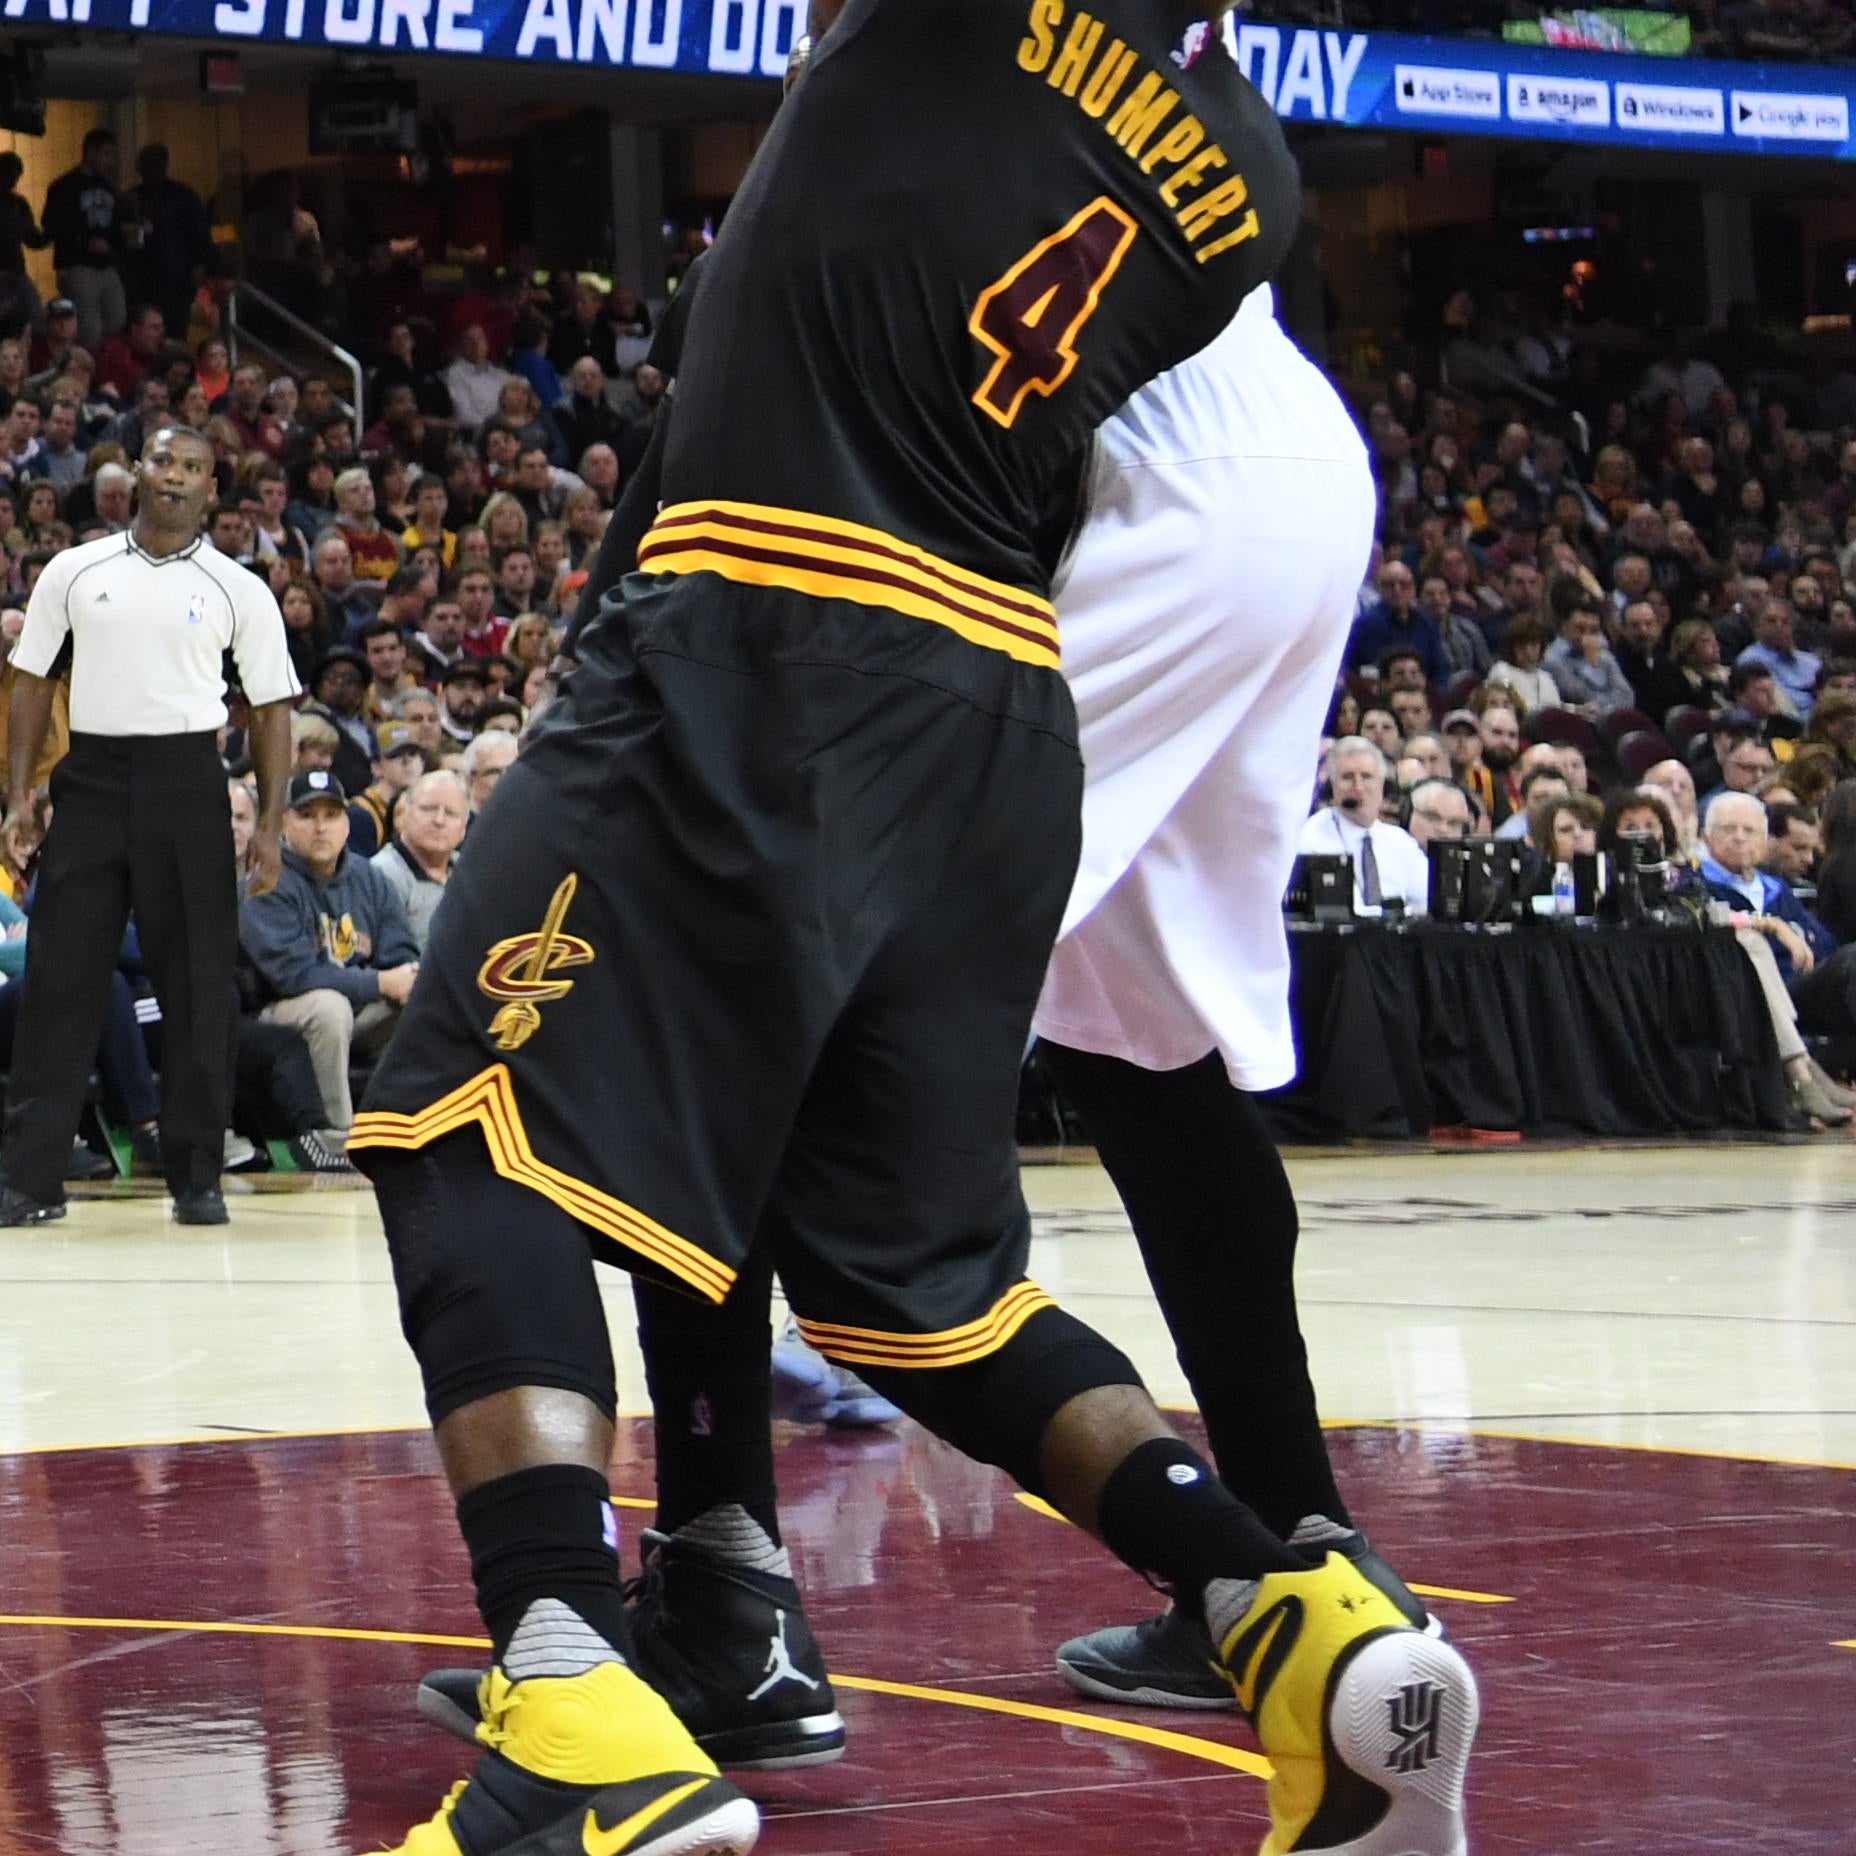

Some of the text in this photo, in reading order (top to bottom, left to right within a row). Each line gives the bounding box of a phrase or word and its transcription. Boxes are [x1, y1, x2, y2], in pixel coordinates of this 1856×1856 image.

[1537, 88, 1599, 111] amazon
[1641, 99, 1715, 121] Windows
[968, 194, 1139, 430] 4
